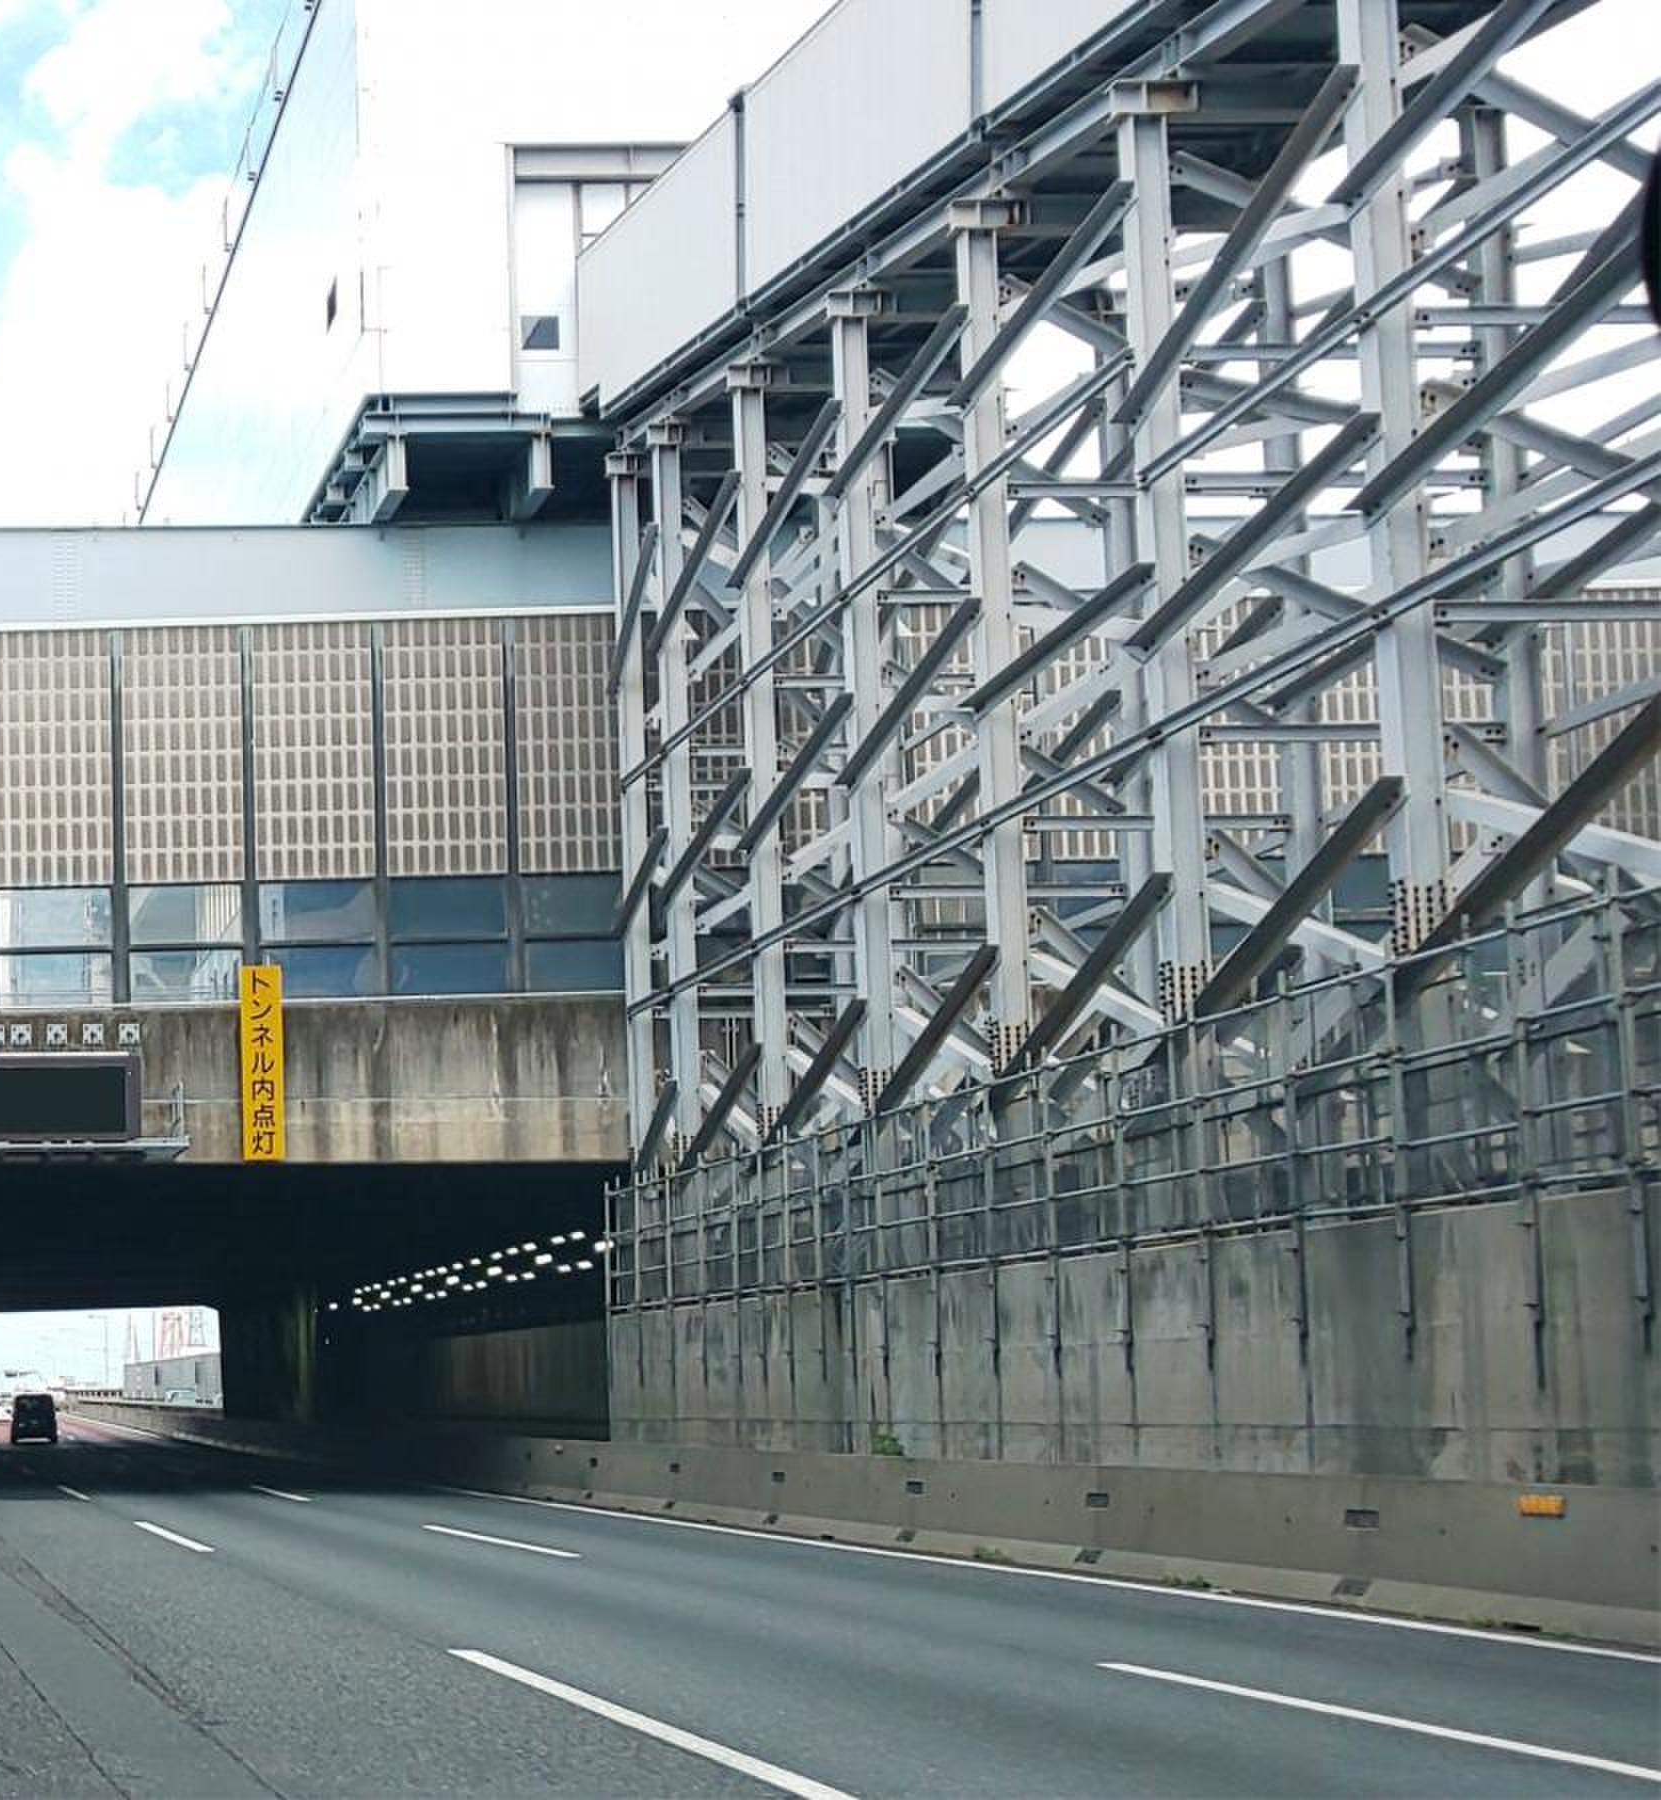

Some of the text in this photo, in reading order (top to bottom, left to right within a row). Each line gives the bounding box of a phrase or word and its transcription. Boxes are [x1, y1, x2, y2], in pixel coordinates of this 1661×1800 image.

[249, 970, 276, 1156] トンネル内点灯
